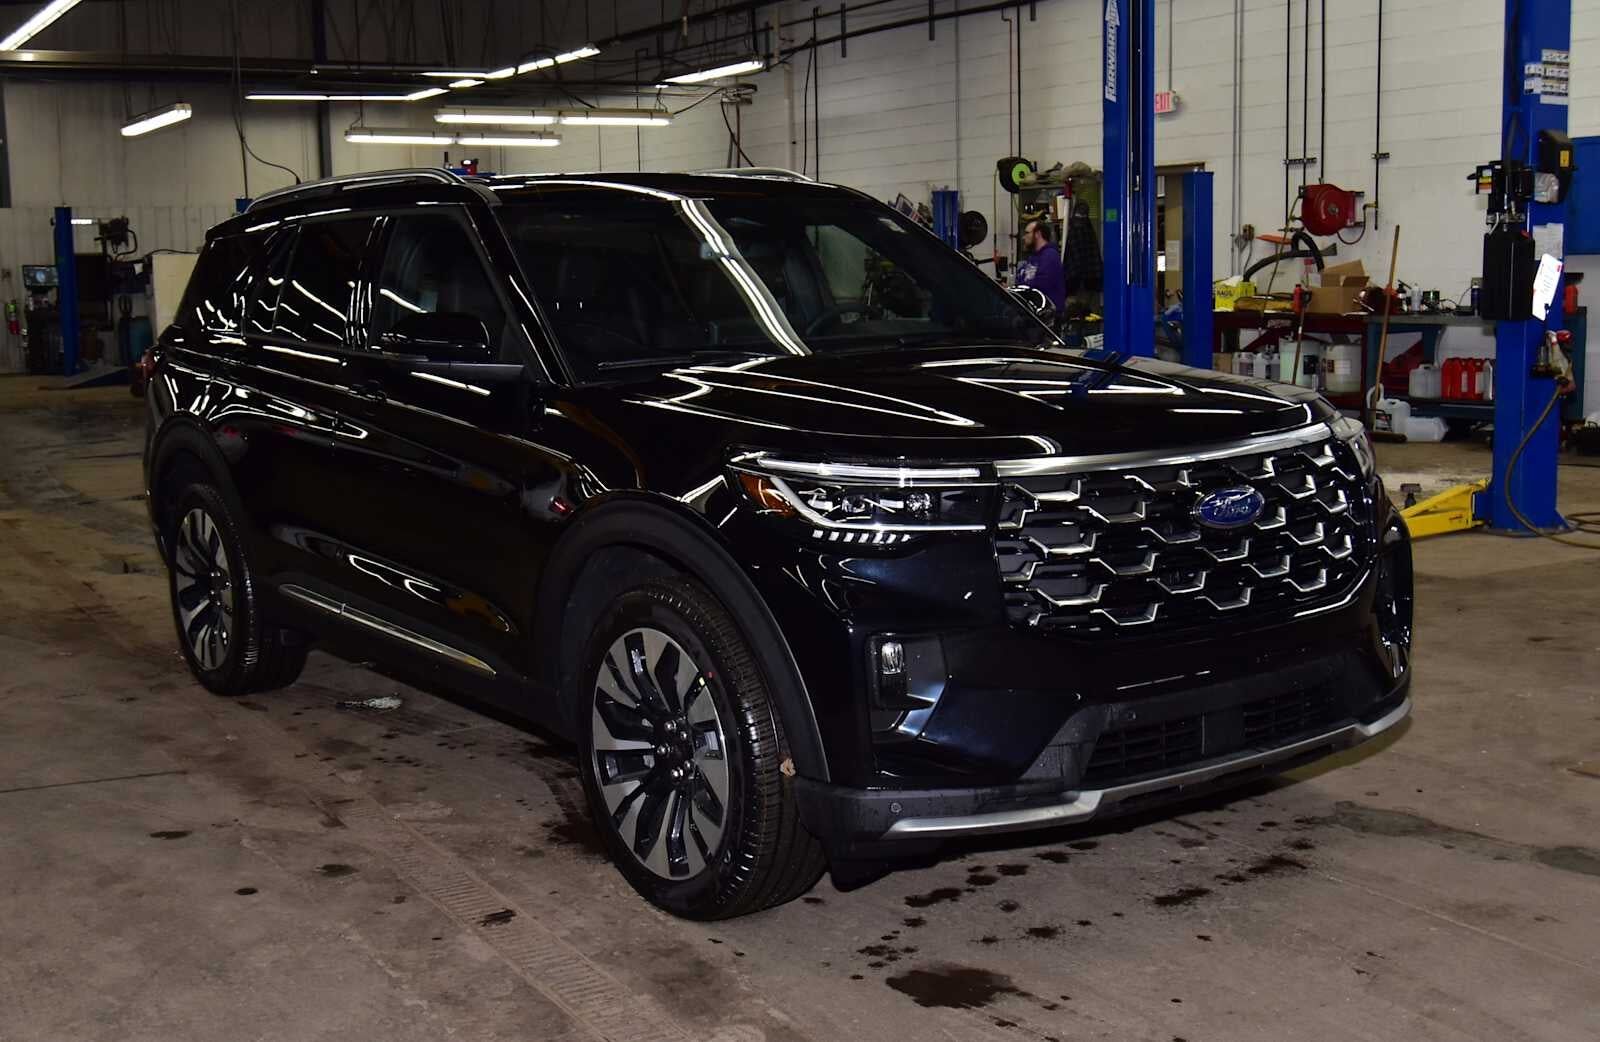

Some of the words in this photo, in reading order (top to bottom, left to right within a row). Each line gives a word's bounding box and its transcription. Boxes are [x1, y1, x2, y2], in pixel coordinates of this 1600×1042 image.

[1104, 24, 1117, 103] FORWARD
[1155, 92, 1170, 112] EXIT
[1206, 492, 1253, 517] Ford
